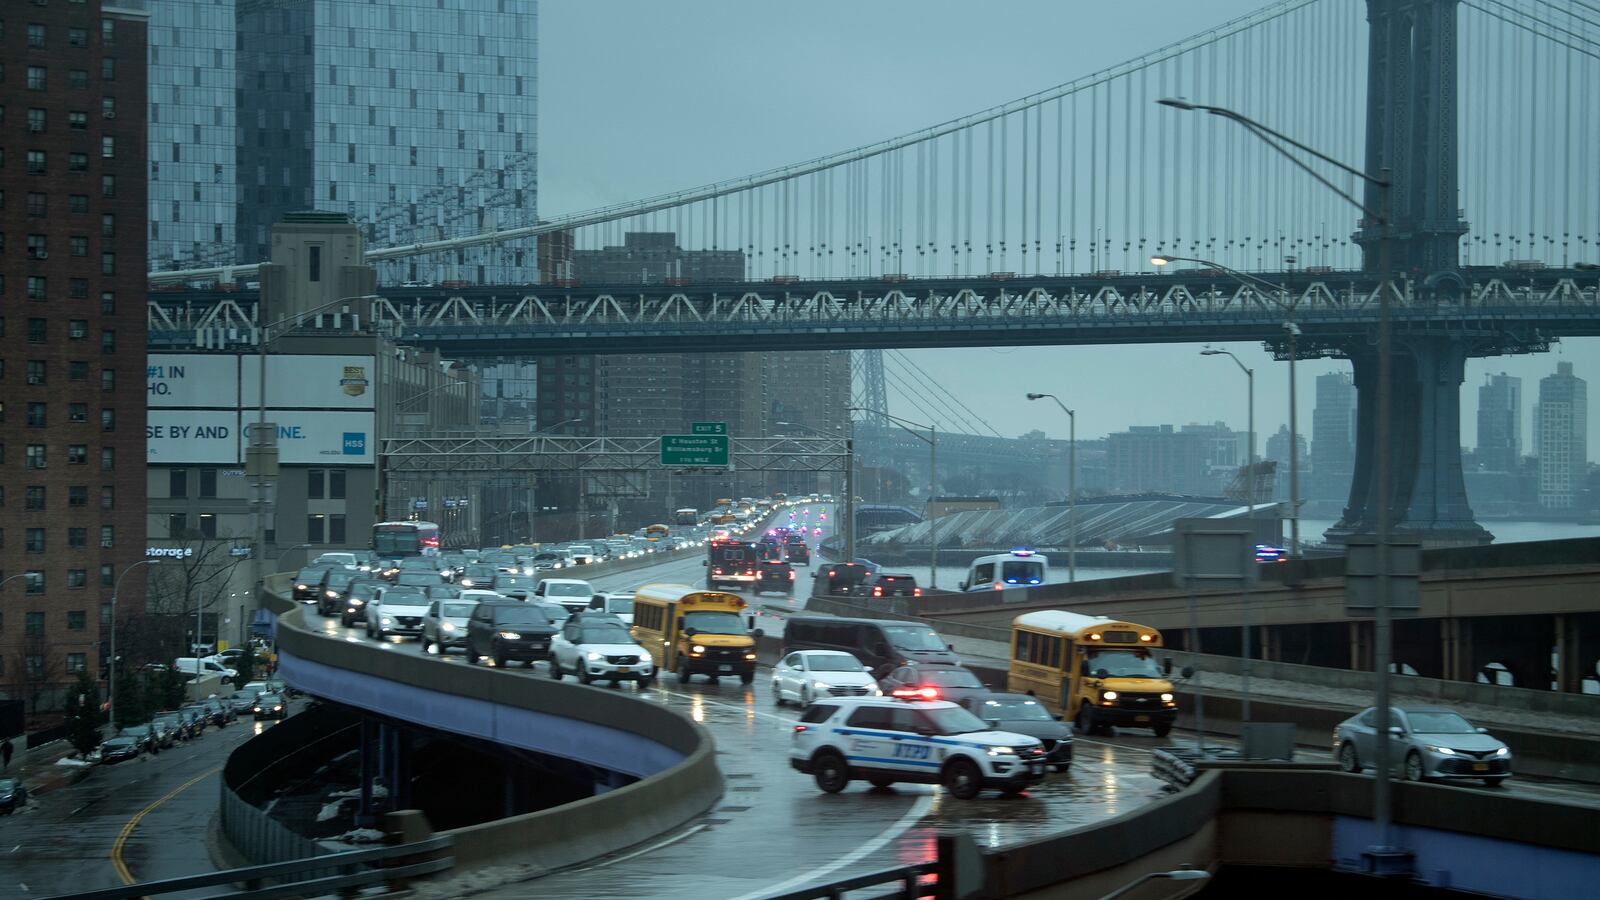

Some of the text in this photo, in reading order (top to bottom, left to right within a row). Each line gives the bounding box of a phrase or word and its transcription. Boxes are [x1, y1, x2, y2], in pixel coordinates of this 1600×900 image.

[169, 366, 184, 378] IN
[170, 426, 190, 438] BY
[195, 426, 228, 439] AND
[145, 547, 192, 559] storage
